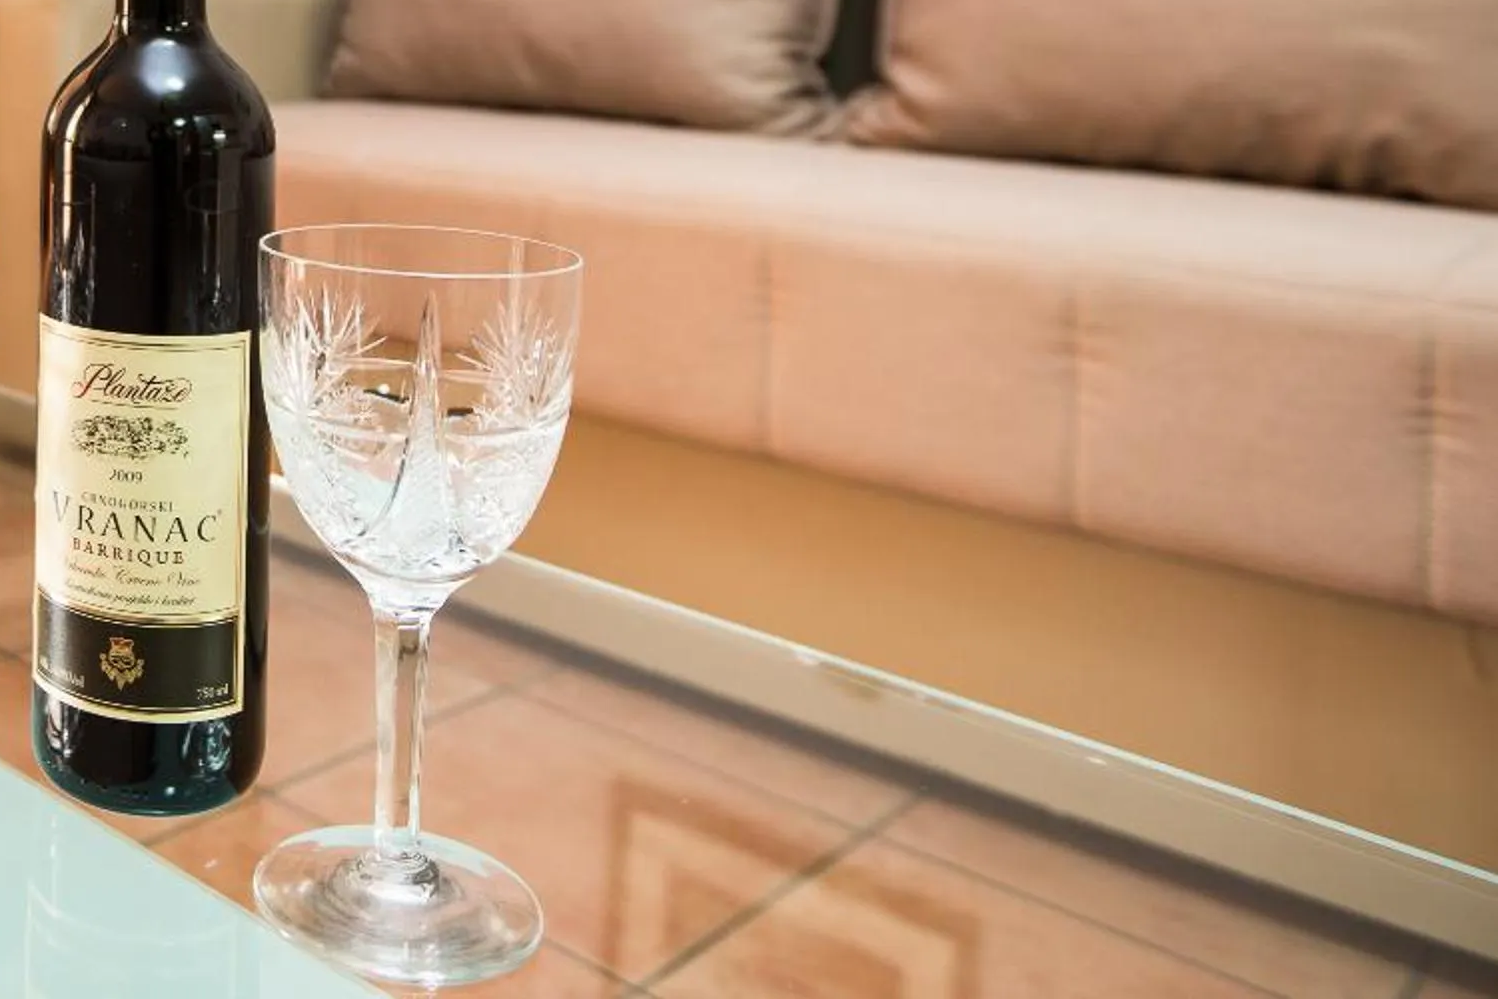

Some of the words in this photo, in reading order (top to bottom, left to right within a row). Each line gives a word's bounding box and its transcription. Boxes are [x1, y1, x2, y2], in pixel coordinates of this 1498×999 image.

[109, 469, 143, 484] 2009
[52, 490, 217, 543] VRANAC
[72, 537, 185, 569] BARRIQUE
